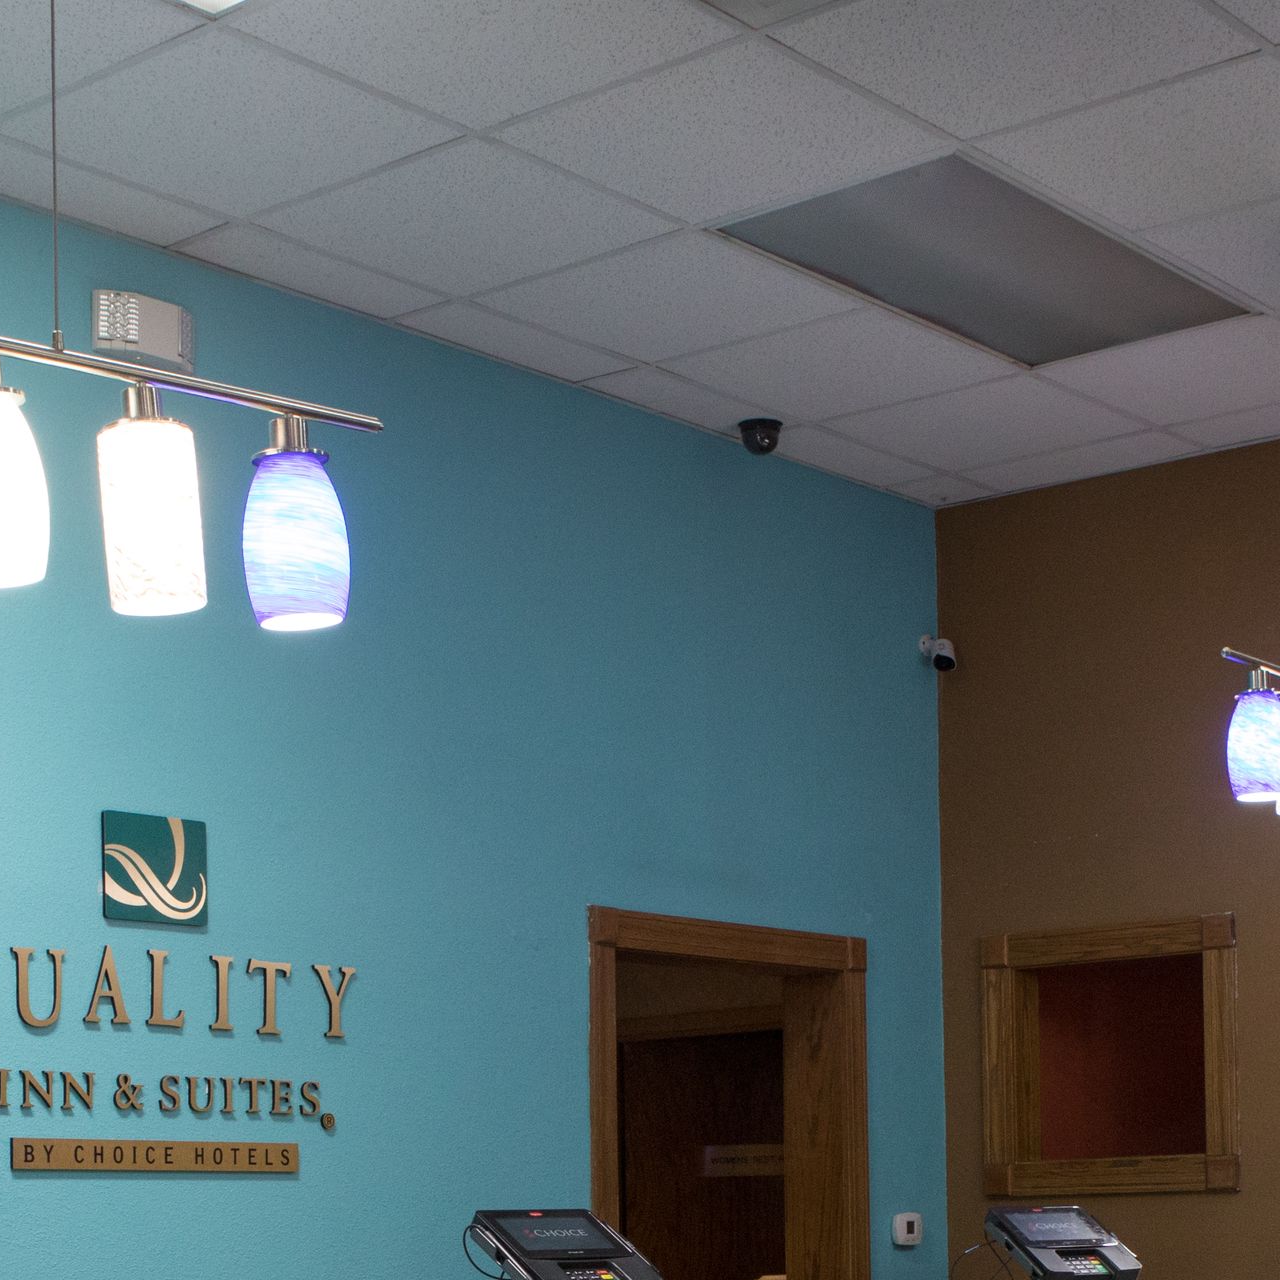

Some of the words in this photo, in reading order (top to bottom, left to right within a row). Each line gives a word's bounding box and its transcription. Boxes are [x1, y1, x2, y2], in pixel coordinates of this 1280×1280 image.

[113, 1073, 145, 1111] &
[23, 1145, 55, 1164] BY
[73, 1145, 175, 1165] CHOICE
[194, 1147, 291, 1167] HOTELS
[533, 1228, 589, 1238] CHOICE
